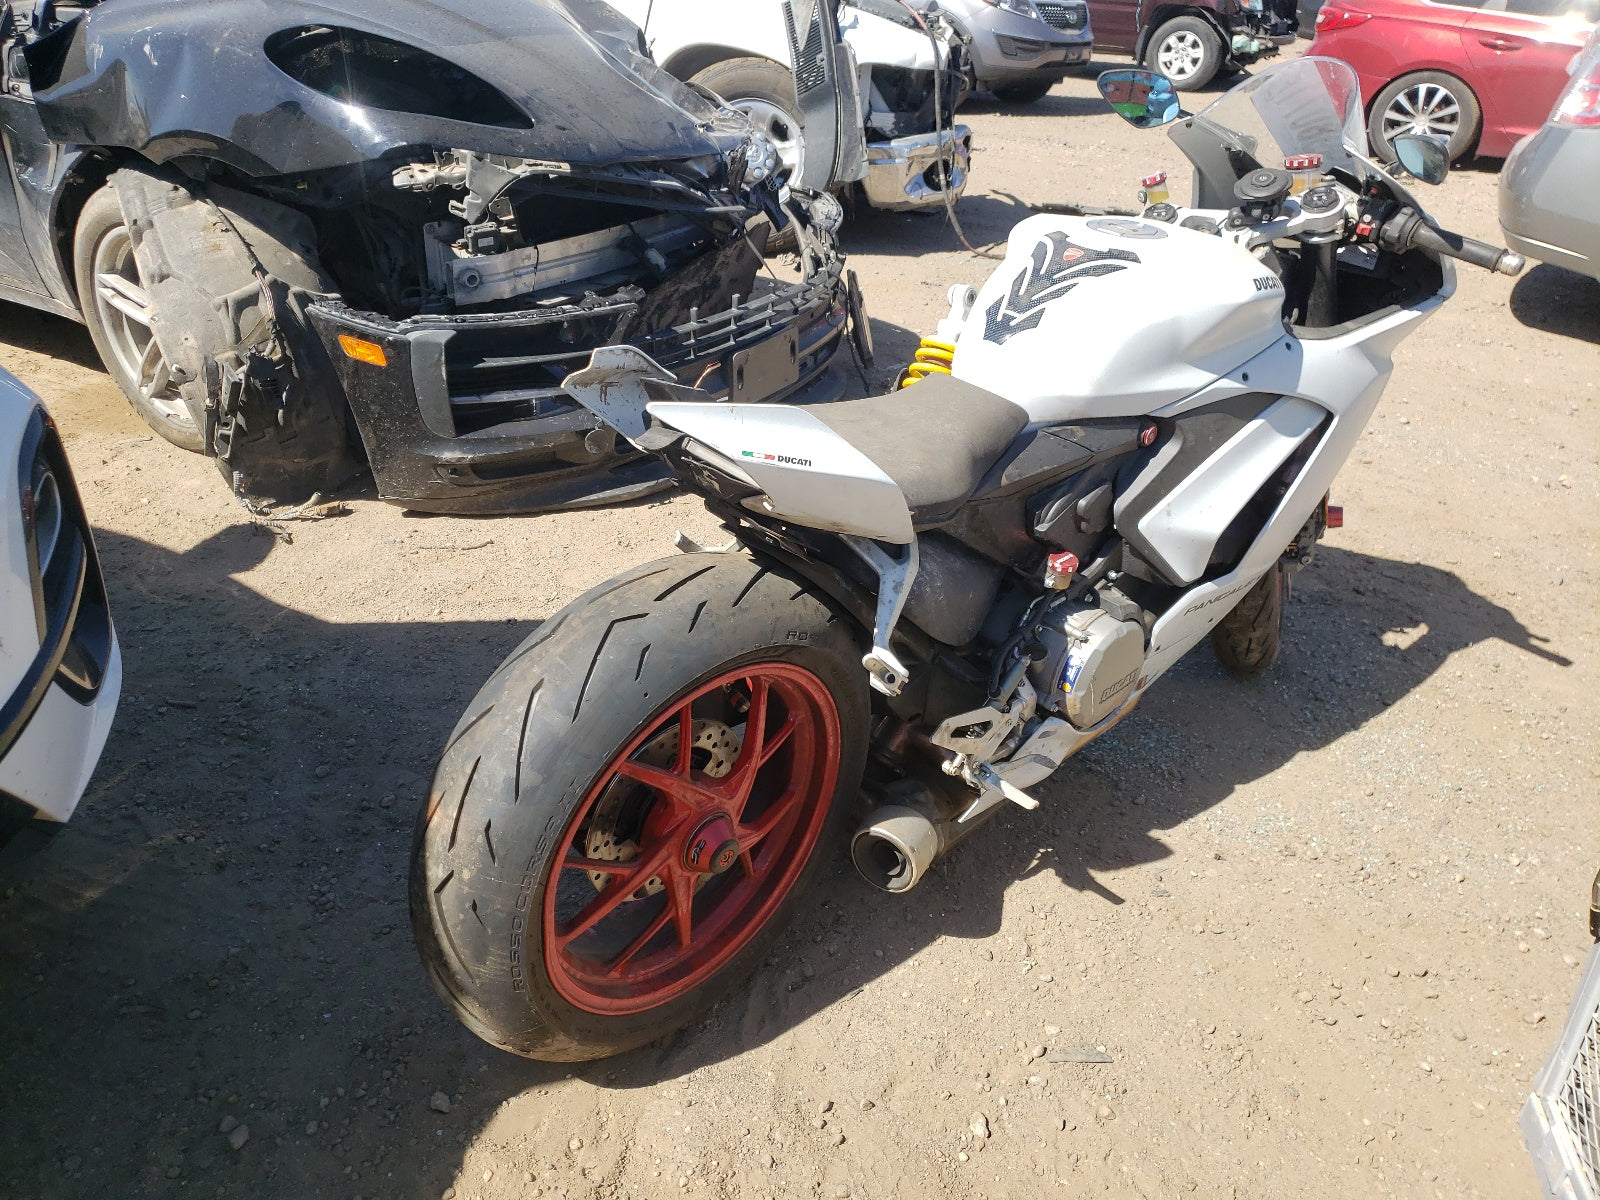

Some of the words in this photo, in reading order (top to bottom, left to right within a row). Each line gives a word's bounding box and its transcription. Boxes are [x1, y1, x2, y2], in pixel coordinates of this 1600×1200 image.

[1252, 276, 1283, 291] DUCATI
[777, 454, 812, 467] DUCATI
[516, 815, 561, 912] CORSA
[510, 915, 526, 993] ROSSO
